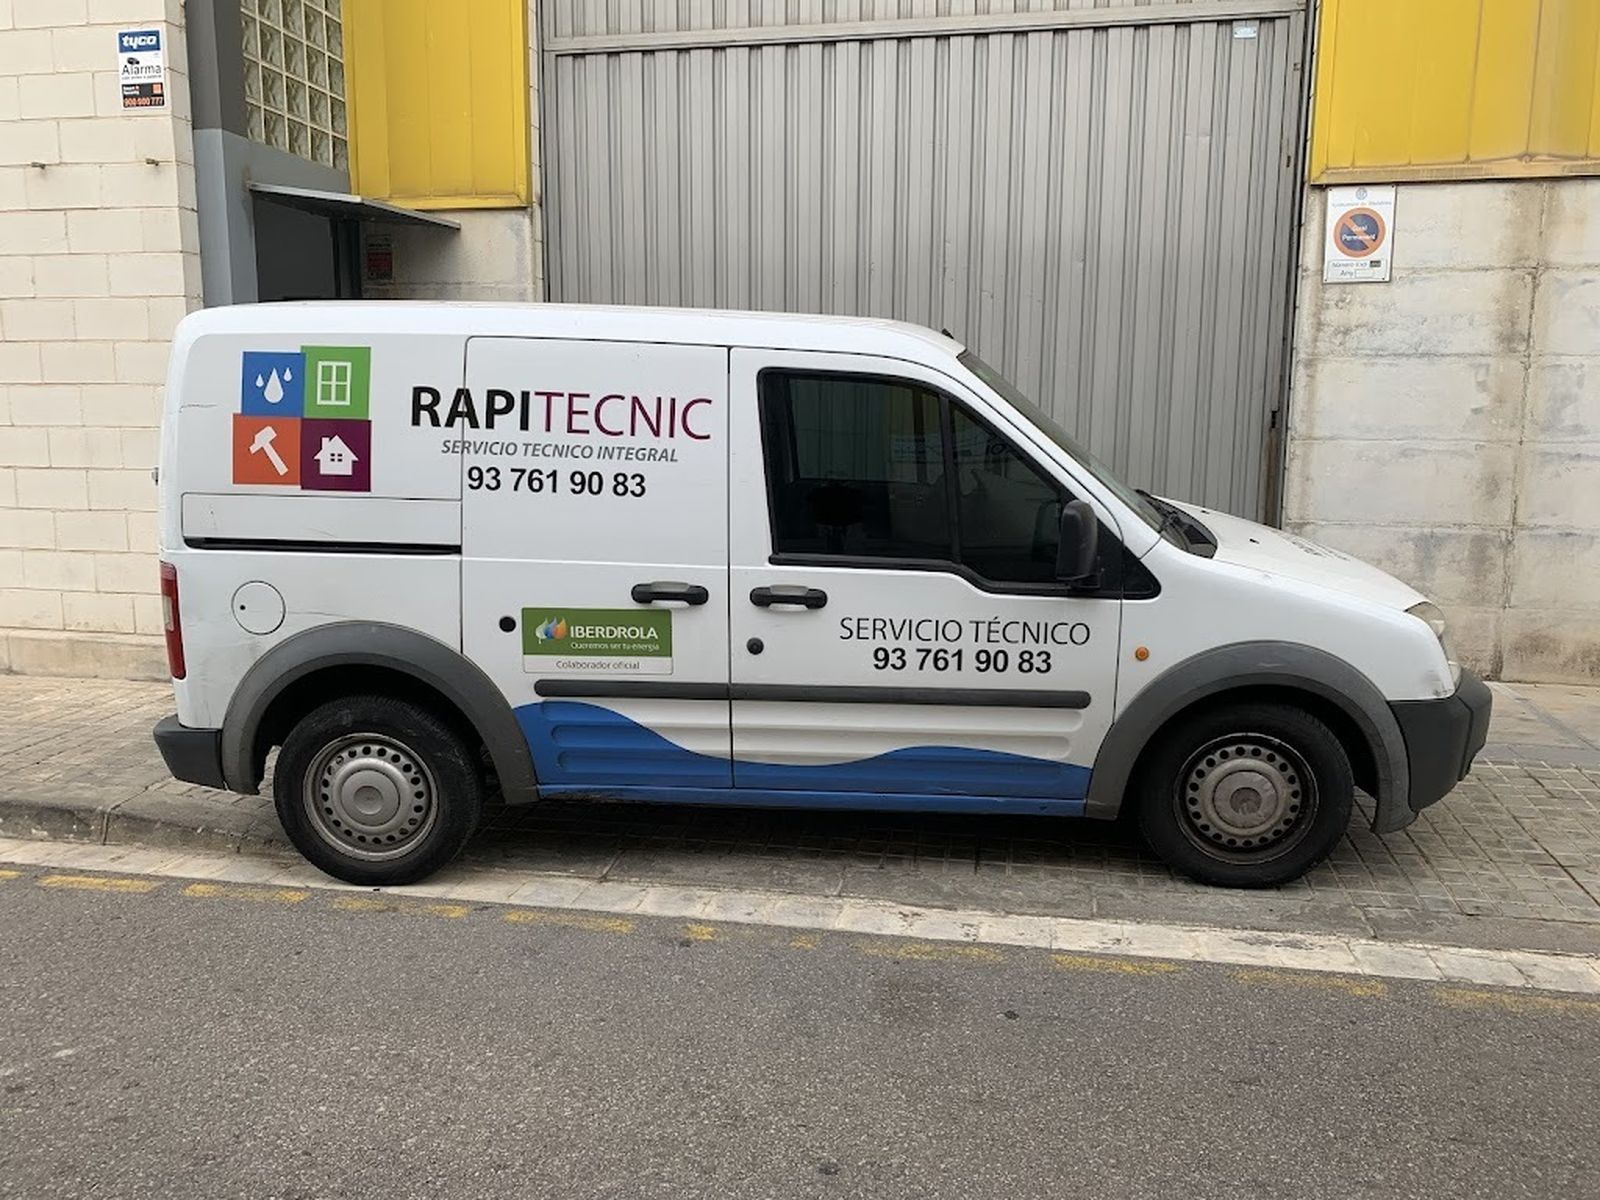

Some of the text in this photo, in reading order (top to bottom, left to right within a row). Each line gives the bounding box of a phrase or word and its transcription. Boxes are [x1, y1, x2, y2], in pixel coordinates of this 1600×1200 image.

[122, 35, 157, 49] tyco
[122, 64, 162, 76] Alarma
[411, 386, 713, 440] RAPITECNIC
[441, 440, 679, 463] SERVICIO TECNICO INTEGRAL
[467, 466, 646, 498] 93 761 90 83
[570, 625, 659, 640] IBERDROLA
[839, 615, 1091, 646] SERVICIO TÉCNICO
[570, 641, 609, 650] Queremos
[556, 660, 640, 670] Colaborador oficial
[873, 647, 1053, 674] 93 761 90 83
